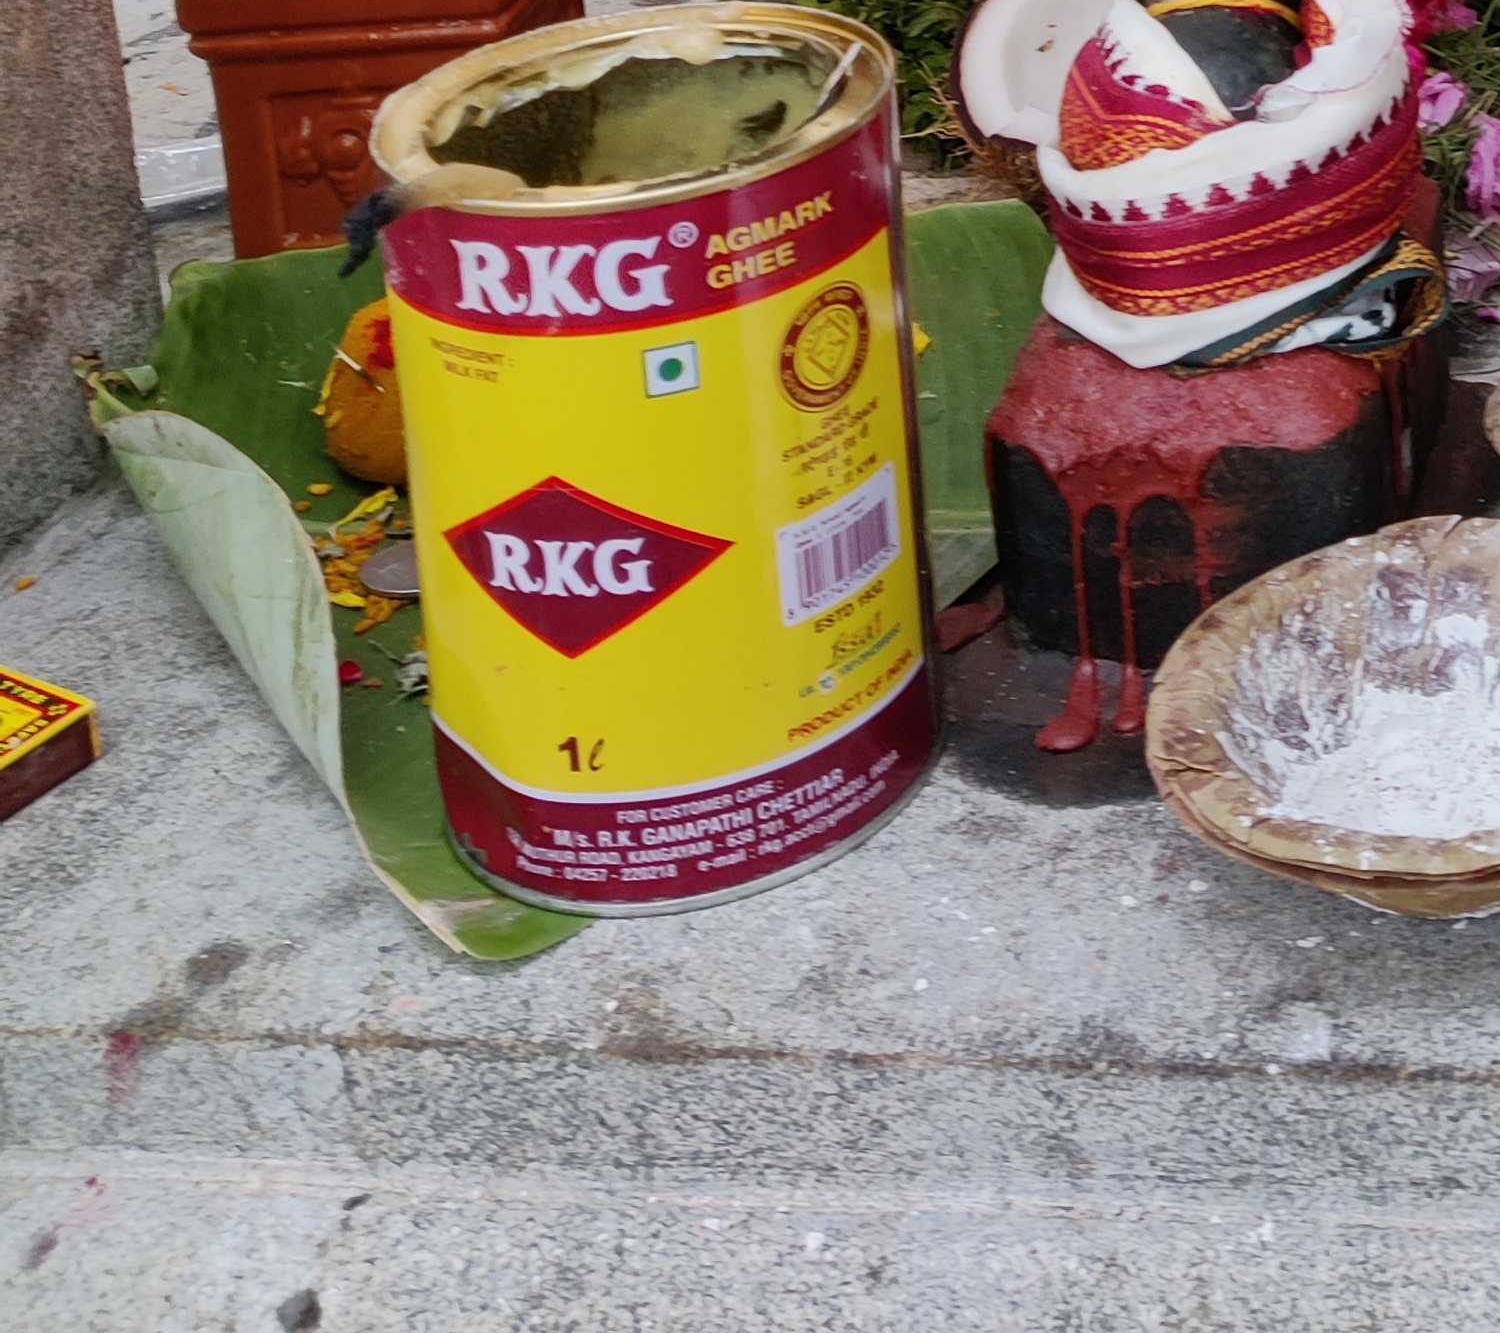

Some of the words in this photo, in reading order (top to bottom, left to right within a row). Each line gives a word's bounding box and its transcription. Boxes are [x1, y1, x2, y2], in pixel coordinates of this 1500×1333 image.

[705, 190, 836, 259] AGMARK
[706, 241, 797, 289] GHEE
[484, 530, 656, 598] RKG
[787, 691, 863, 743] PRODUCT
[865, 676, 884, 697] OF
[615, 809, 649, 824] FOR
[650, 794, 734, 822] CUSTOMER
[641, 807, 754, 846] GANAPATHI
[757, 768, 845, 820] CHETTIAR
[627, 839, 714, 864] KANGAYAM
[697, 848, 748, 872] e-mail
